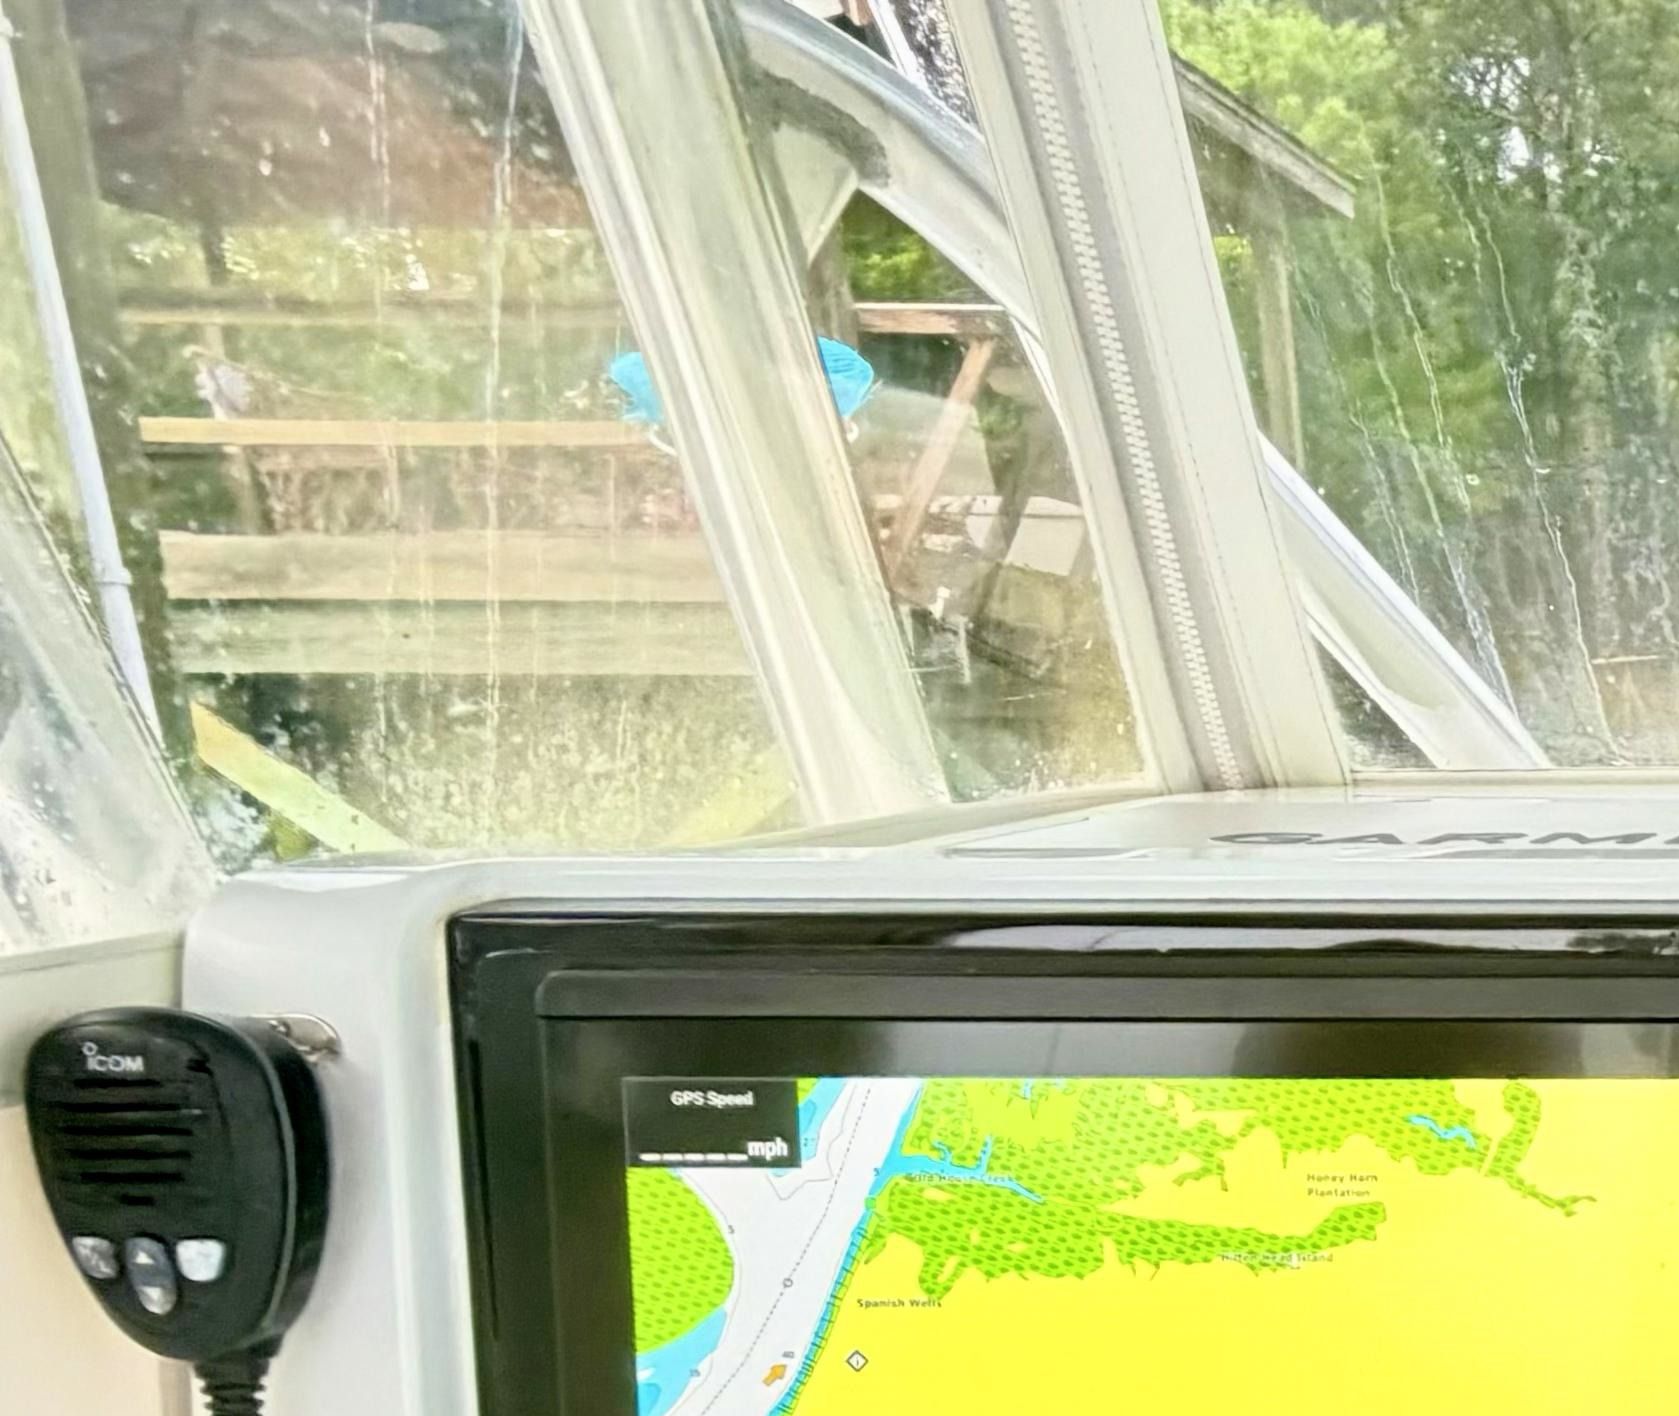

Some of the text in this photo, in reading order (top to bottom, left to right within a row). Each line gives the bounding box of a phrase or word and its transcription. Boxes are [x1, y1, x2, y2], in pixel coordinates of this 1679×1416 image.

[670, 1090, 755, 1109] GPS Speed
[747, 1137, 788, 1161] mph
